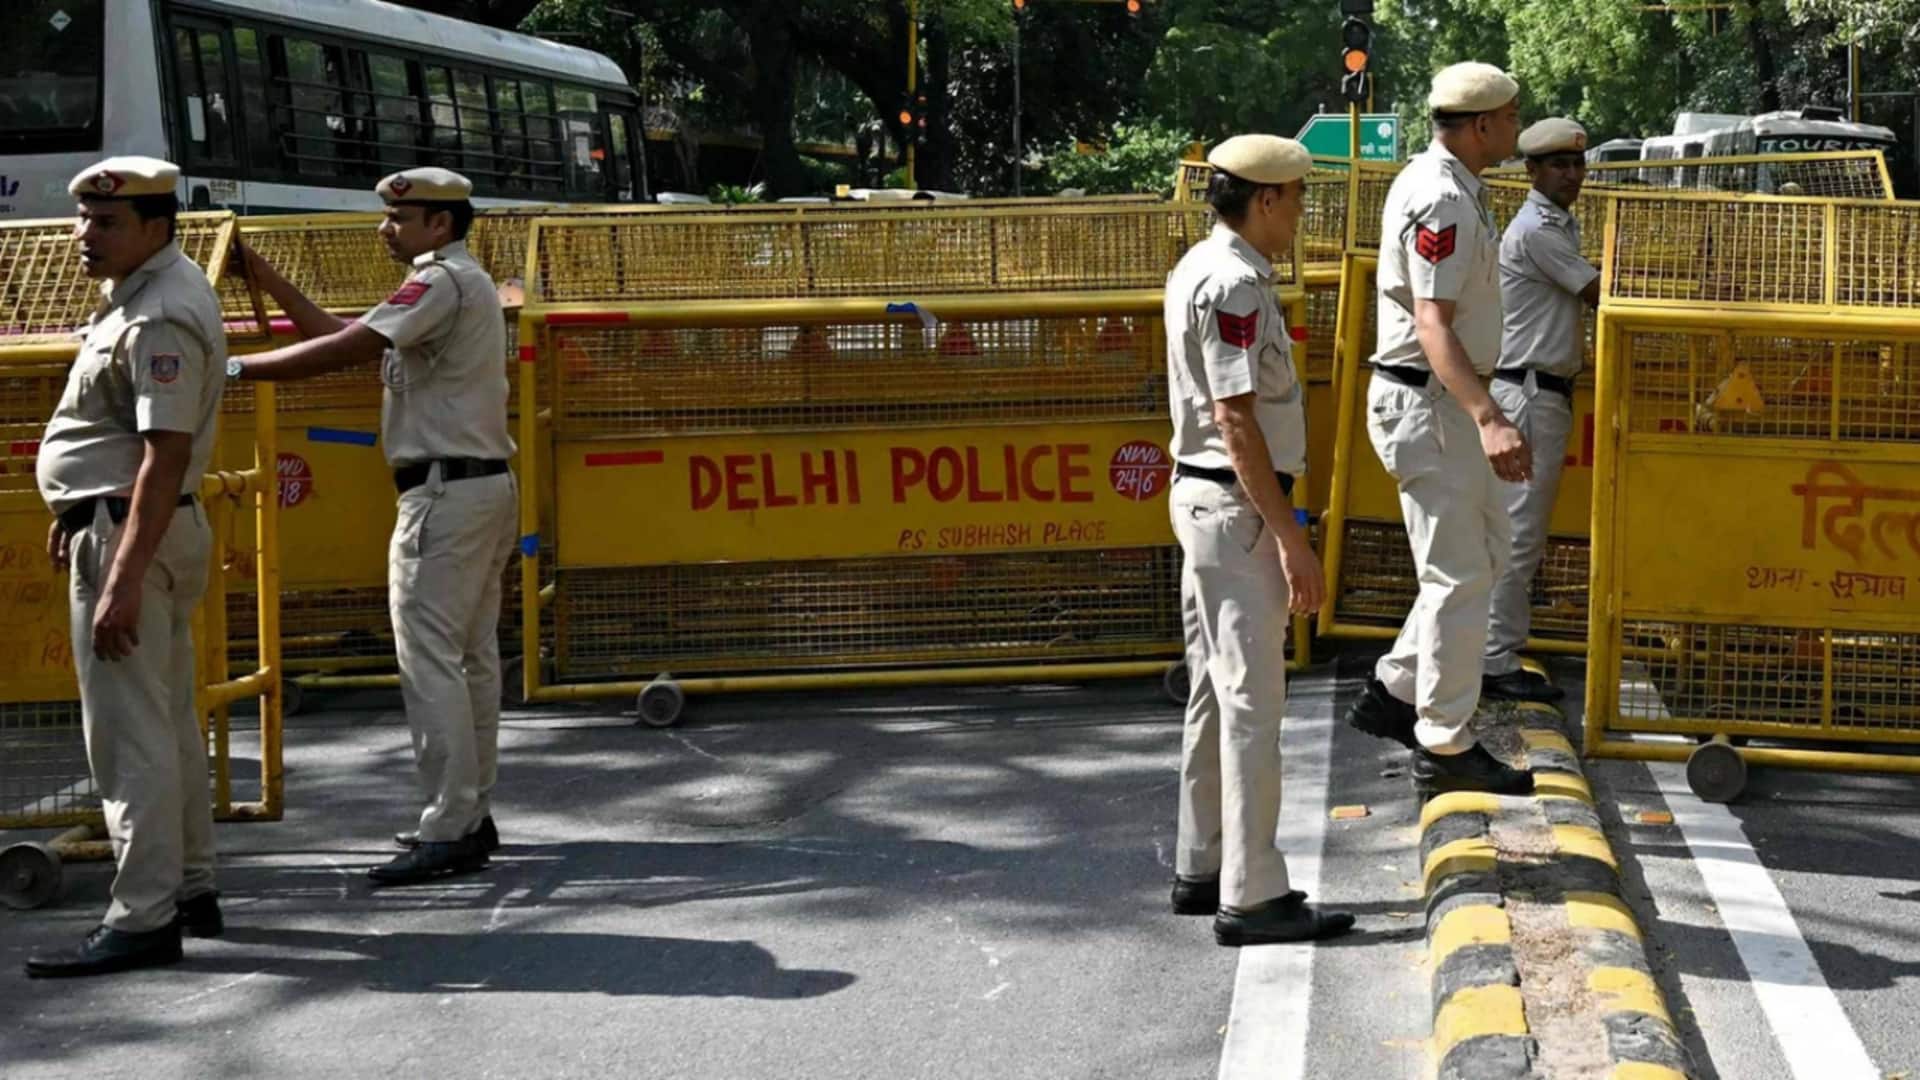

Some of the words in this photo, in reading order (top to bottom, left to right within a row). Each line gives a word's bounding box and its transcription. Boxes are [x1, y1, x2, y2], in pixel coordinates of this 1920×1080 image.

[689, 449, 861, 511] DELHI
[889, 443, 1095, 503] POLICE
[937, 522, 1031, 549] SUBHASH
[1043, 520, 1105, 544] PLACE
